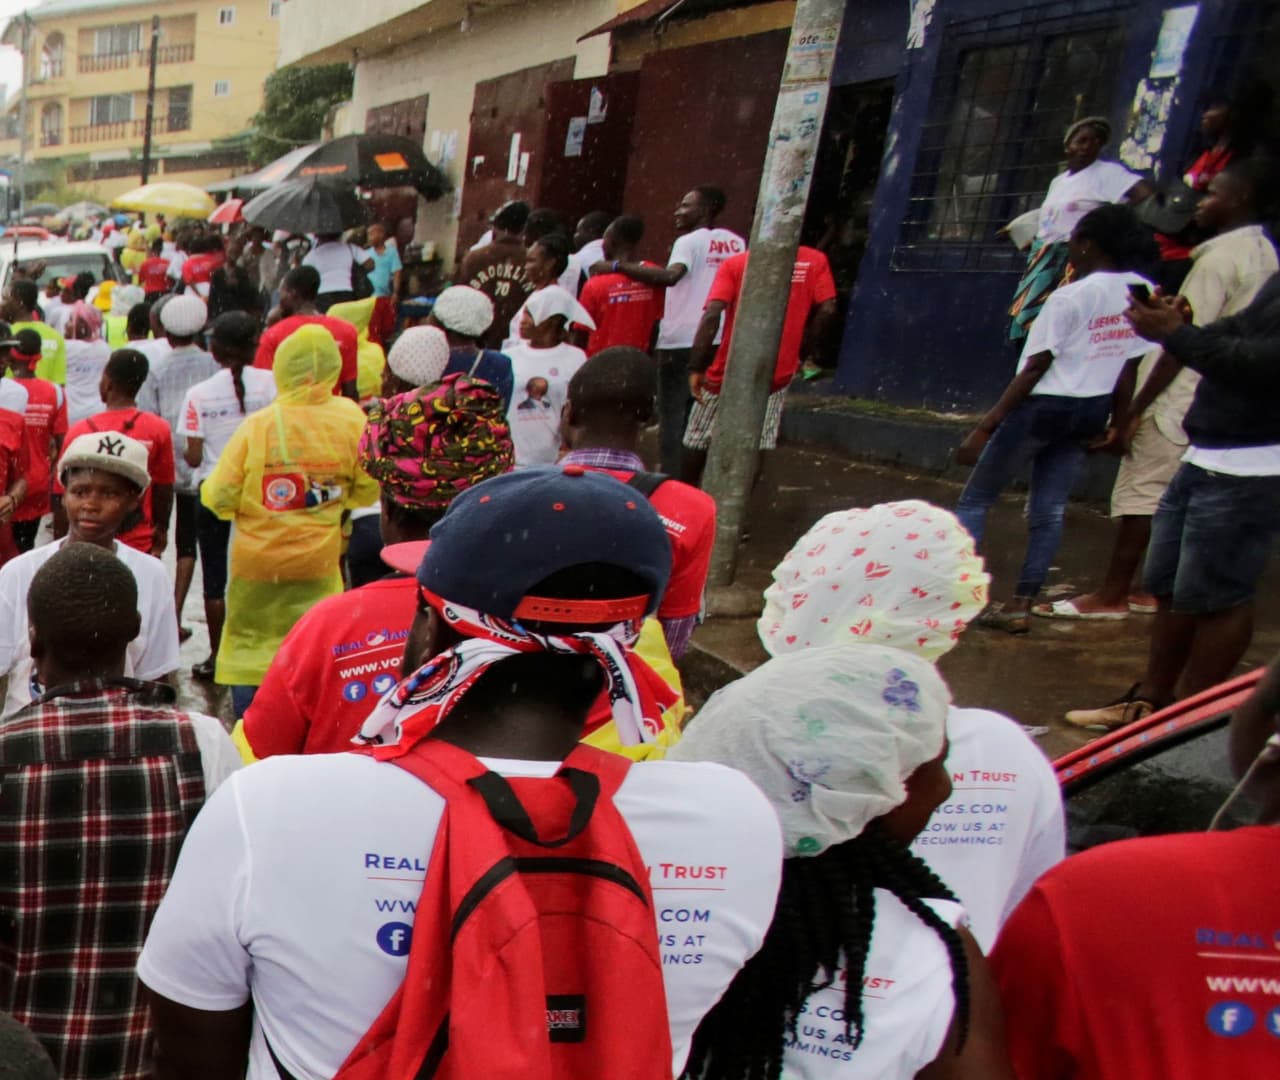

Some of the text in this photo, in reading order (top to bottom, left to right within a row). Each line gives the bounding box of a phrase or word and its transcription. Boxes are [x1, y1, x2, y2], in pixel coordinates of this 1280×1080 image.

[495, 281, 510, 296] 70
[970, 770, 1017, 783] TRUST
[962, 822, 982, 832] US
[364, 852, 728, 880] REAL TRUST
[683, 935, 706, 947] AT
[1196, 927, 1269, 949] REAL
[803, 1025, 827, 1040] US
